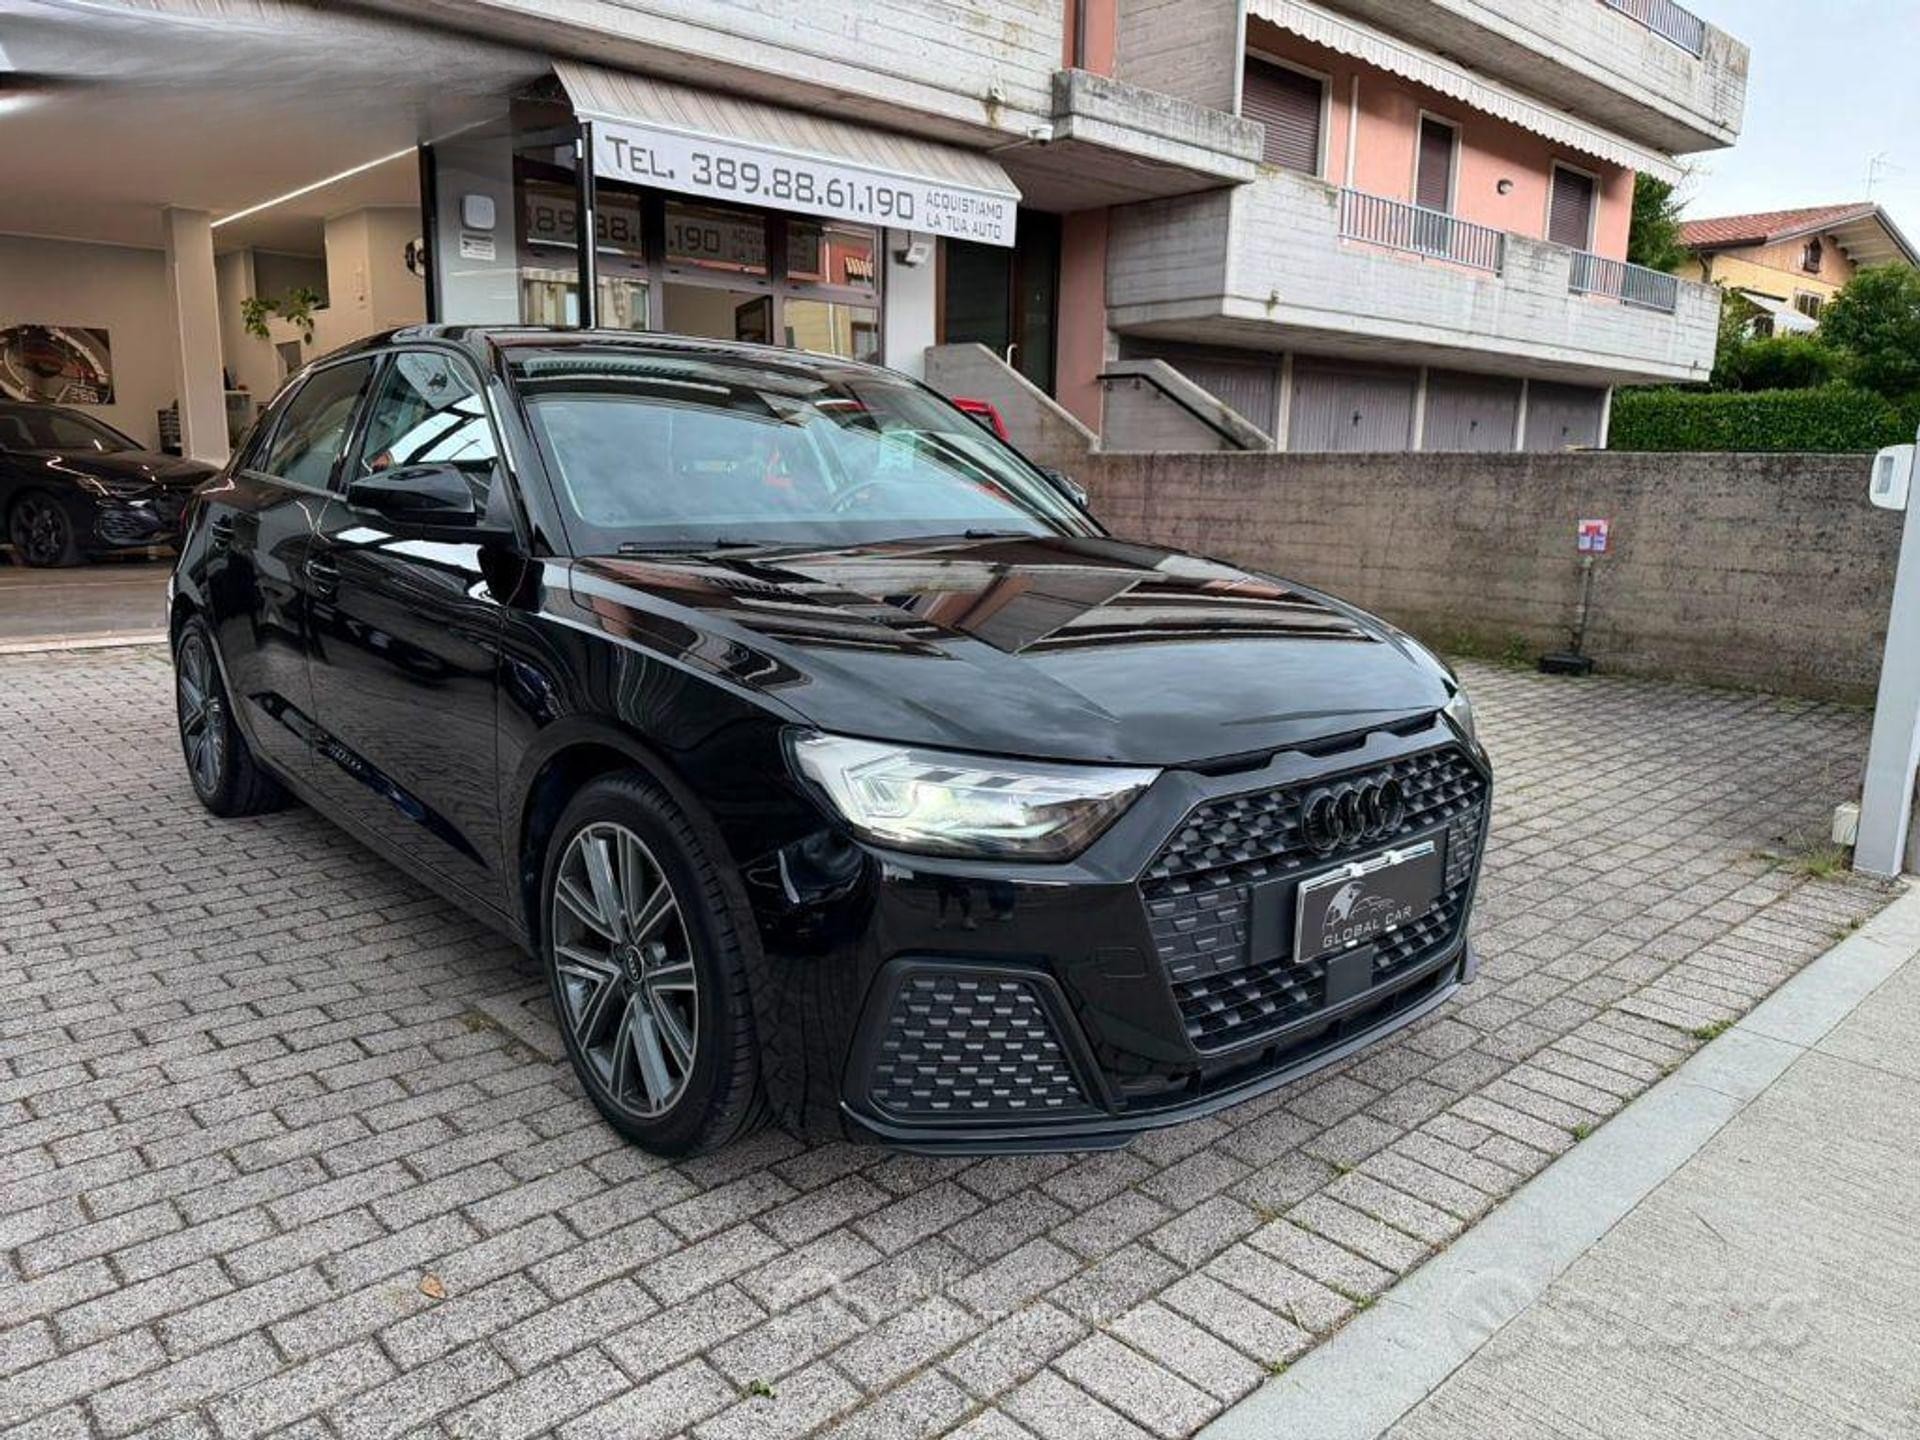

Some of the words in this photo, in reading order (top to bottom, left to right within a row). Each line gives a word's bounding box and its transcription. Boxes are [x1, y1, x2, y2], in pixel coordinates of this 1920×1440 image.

[605, 135, 675, 180] TEL.
[692, 152, 914, 221] 389.88.61.190
[926, 192, 1002, 220] ACQUISTIAMO
[926, 212, 942, 228] LA
[946, 214, 969, 233] TUA
[971, 221, 1001, 240] AUTO
[1323, 919, 1380, 948] GLOBAL
[1385, 905, 1412, 925] CAR
